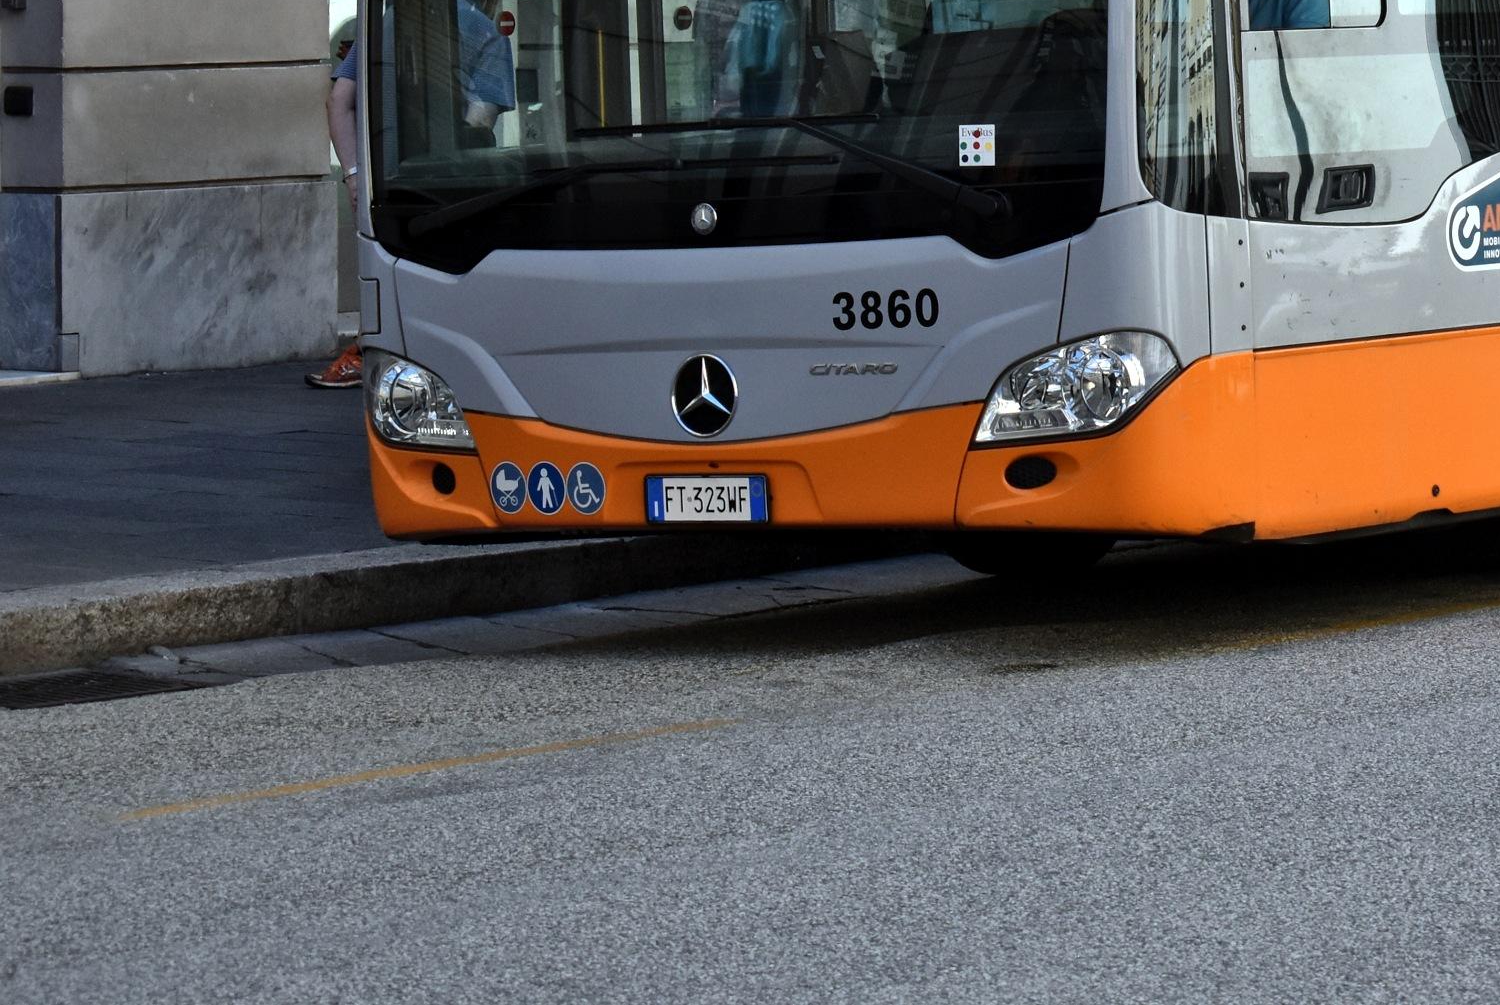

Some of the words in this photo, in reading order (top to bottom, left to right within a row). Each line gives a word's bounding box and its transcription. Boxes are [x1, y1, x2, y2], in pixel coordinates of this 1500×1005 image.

[961, 127, 993, 138] EvBus
[831, 287, 940, 332] 3860
[808, 362, 898, 376] CITARO
